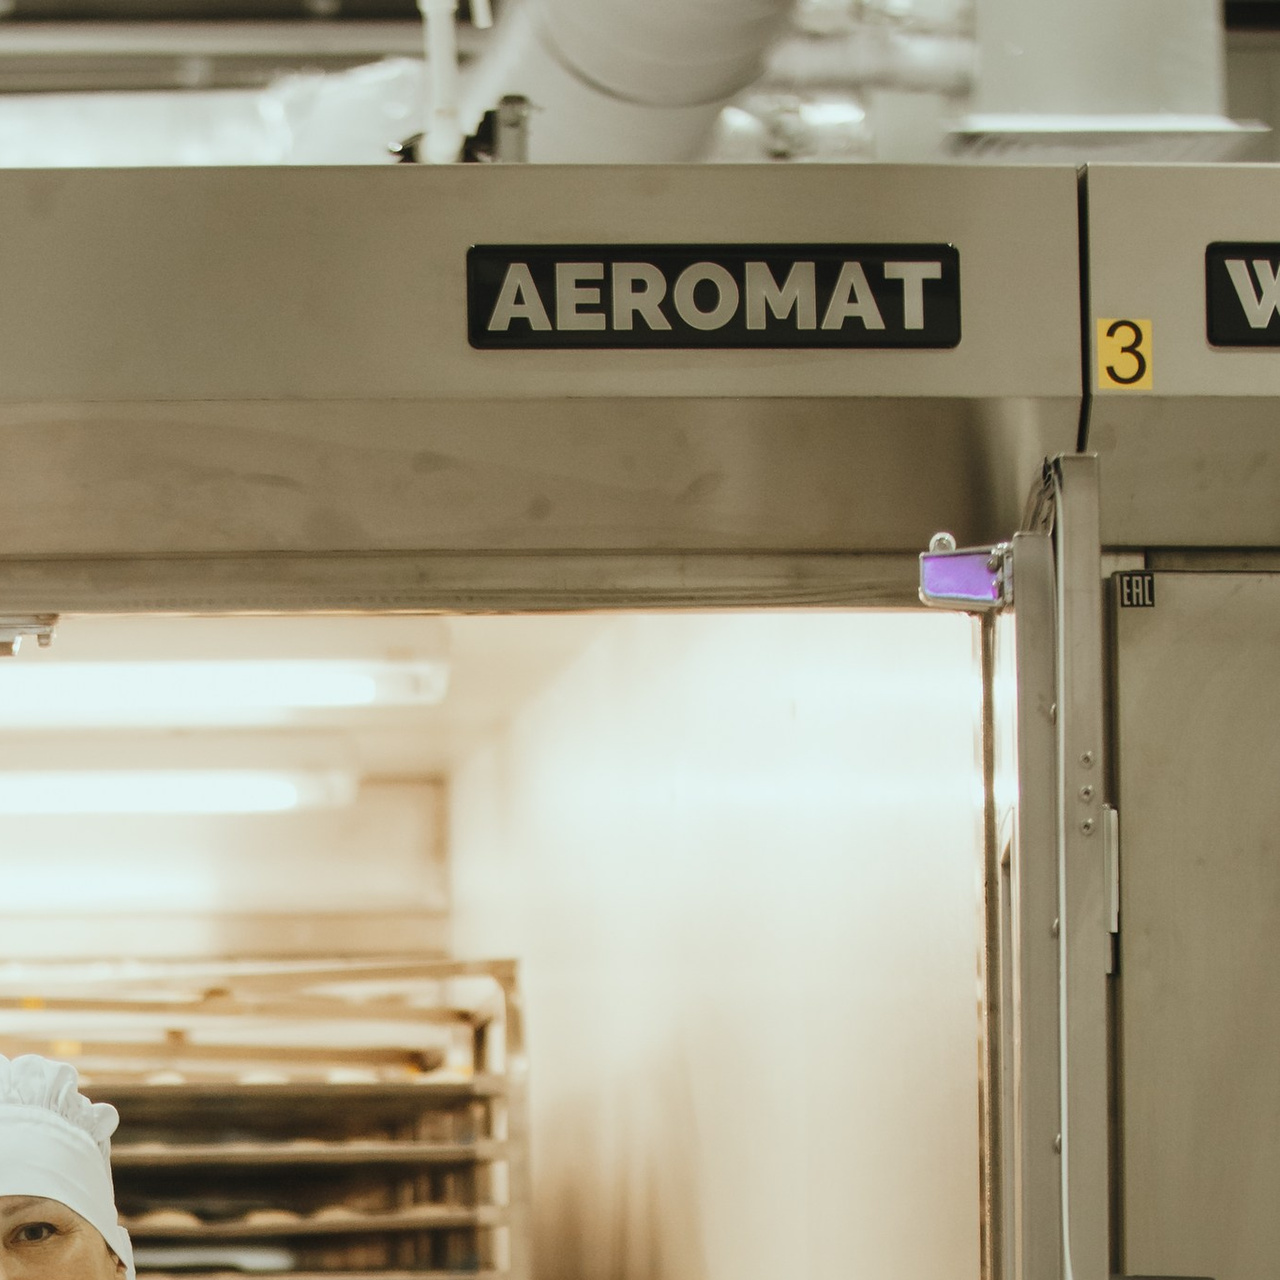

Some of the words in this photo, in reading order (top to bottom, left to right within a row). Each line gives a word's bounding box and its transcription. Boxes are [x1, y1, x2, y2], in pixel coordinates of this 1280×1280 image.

[487, 261, 942, 331] AEROMAT
[1106, 320, 1146, 385] 3
[1122, 575, 1153, 606] EAC
